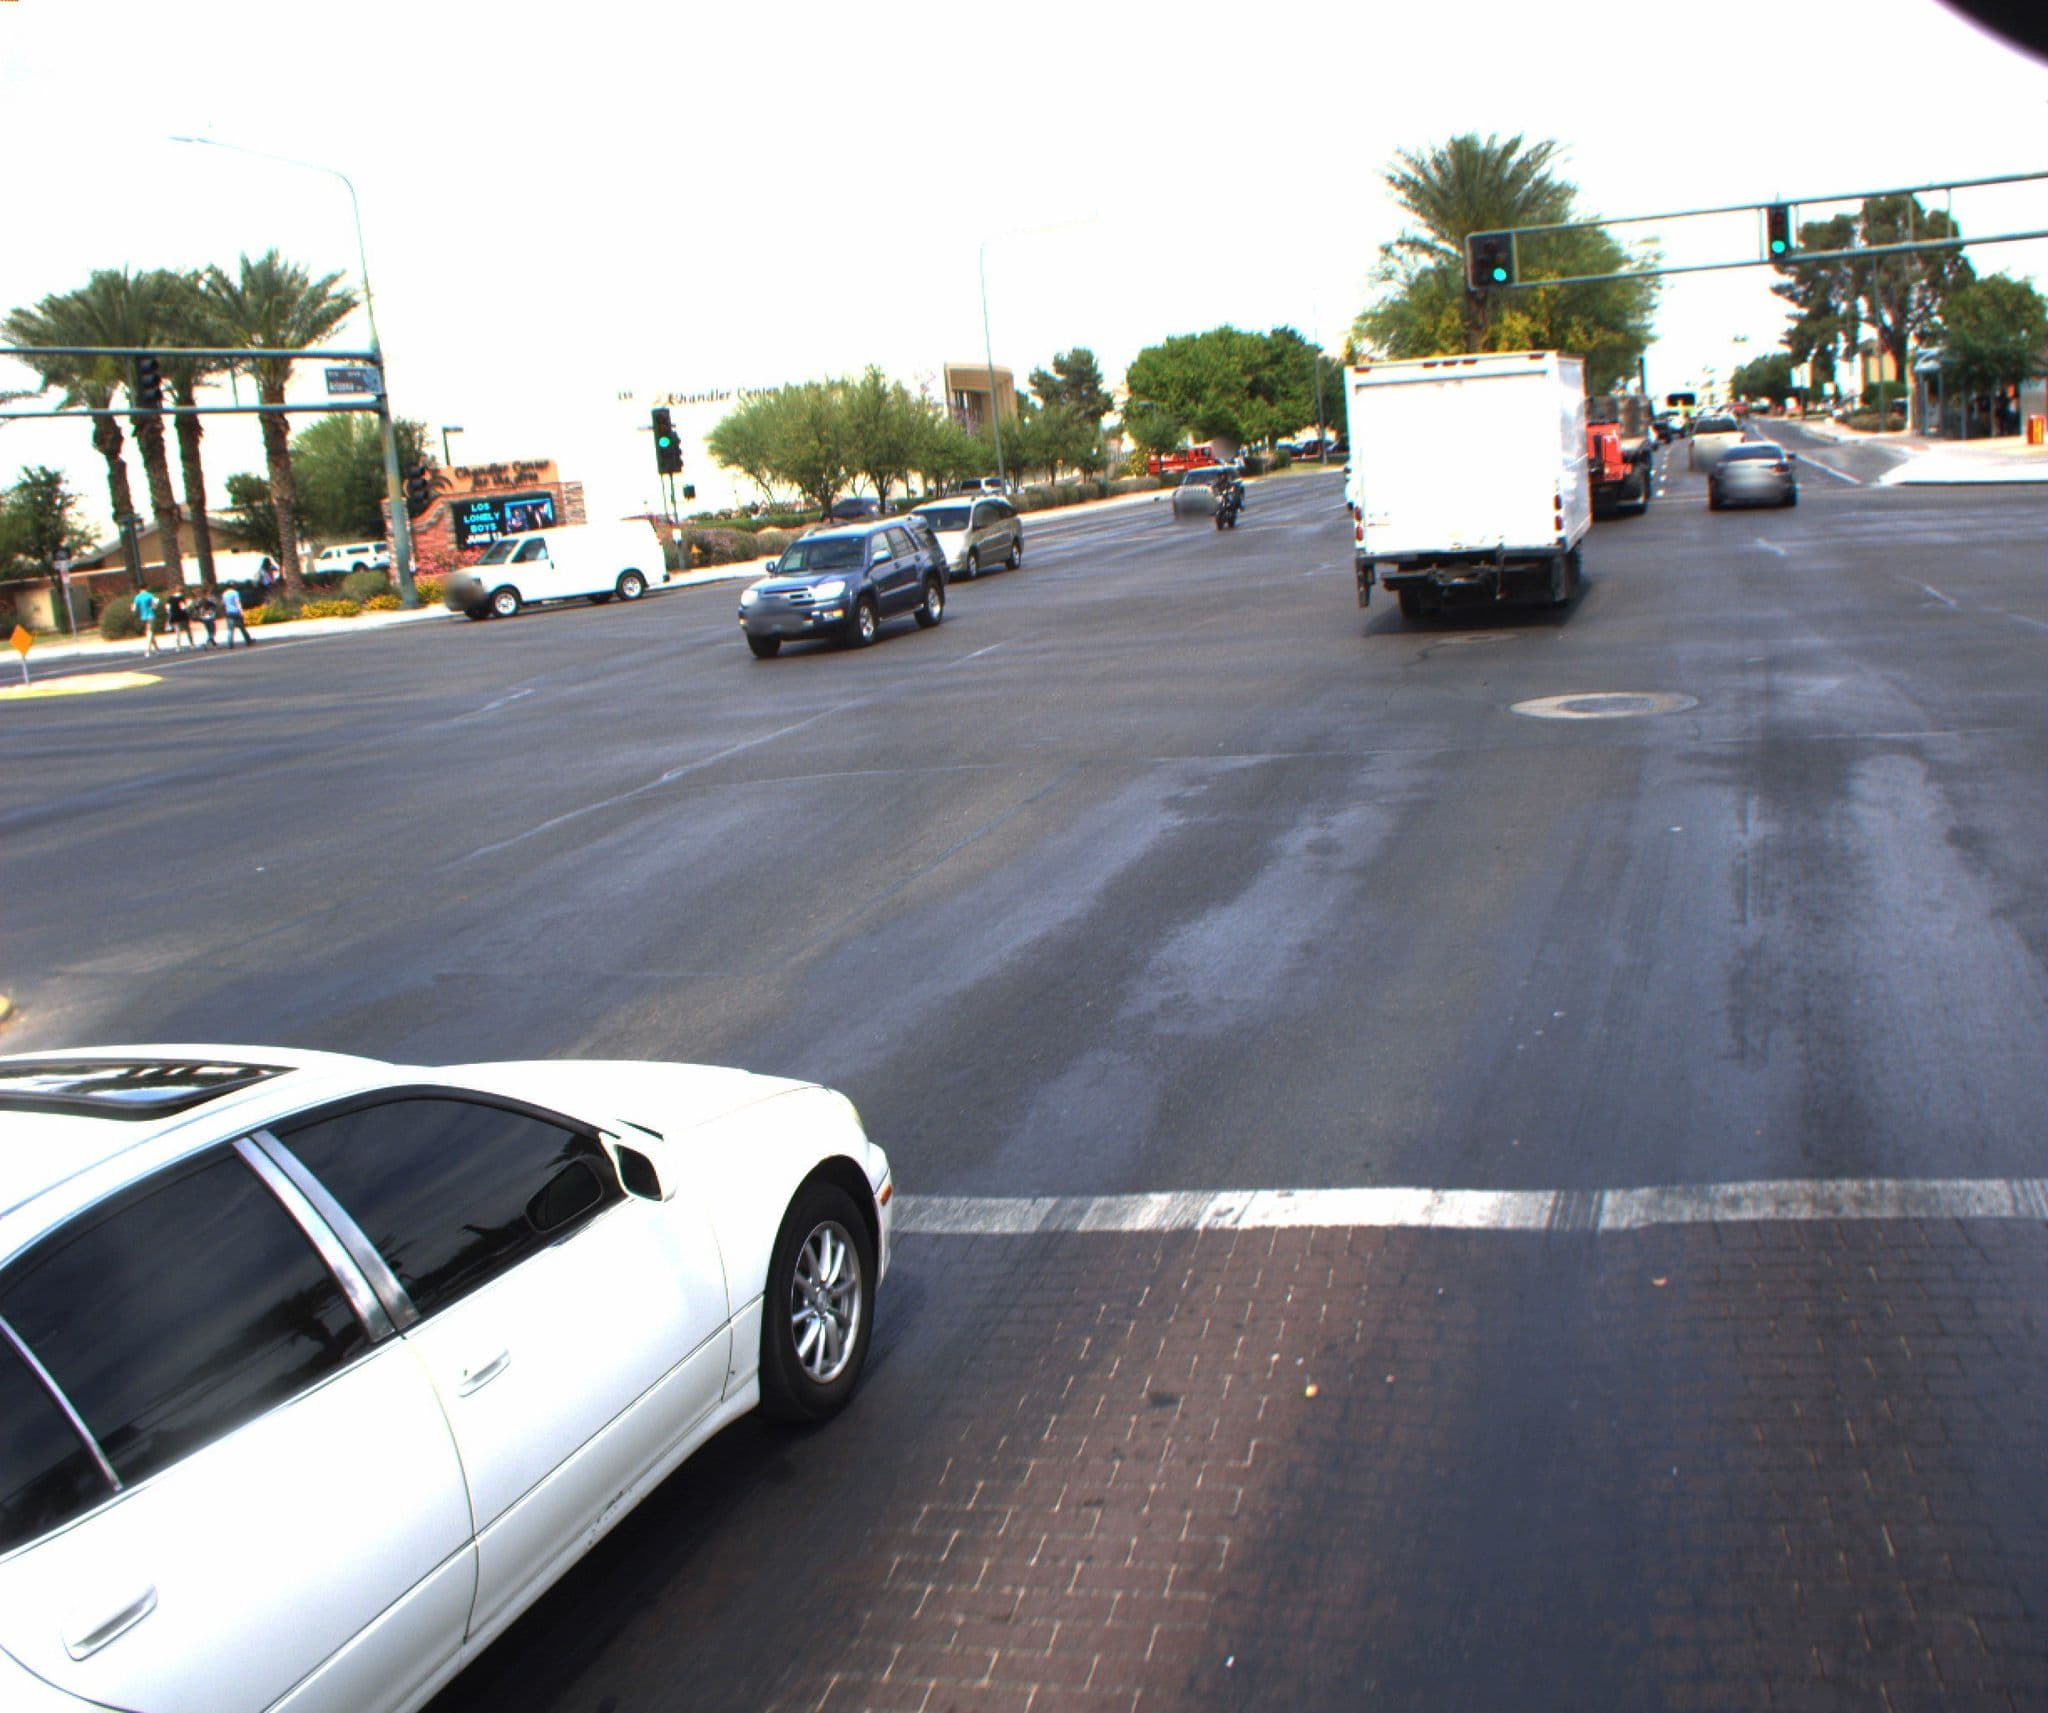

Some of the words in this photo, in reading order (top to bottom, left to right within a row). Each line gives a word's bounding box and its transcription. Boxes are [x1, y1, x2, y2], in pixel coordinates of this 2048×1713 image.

[667, 388, 731, 405] Chandler
[455, 463, 508, 480] Chandler
[512, 460, 549, 473] Center
[471, 502, 490, 513] LOS
[463, 511, 500, 525] LONELY
[469, 522, 497, 534] BOYS
[465, 534, 491, 546] JUNE
